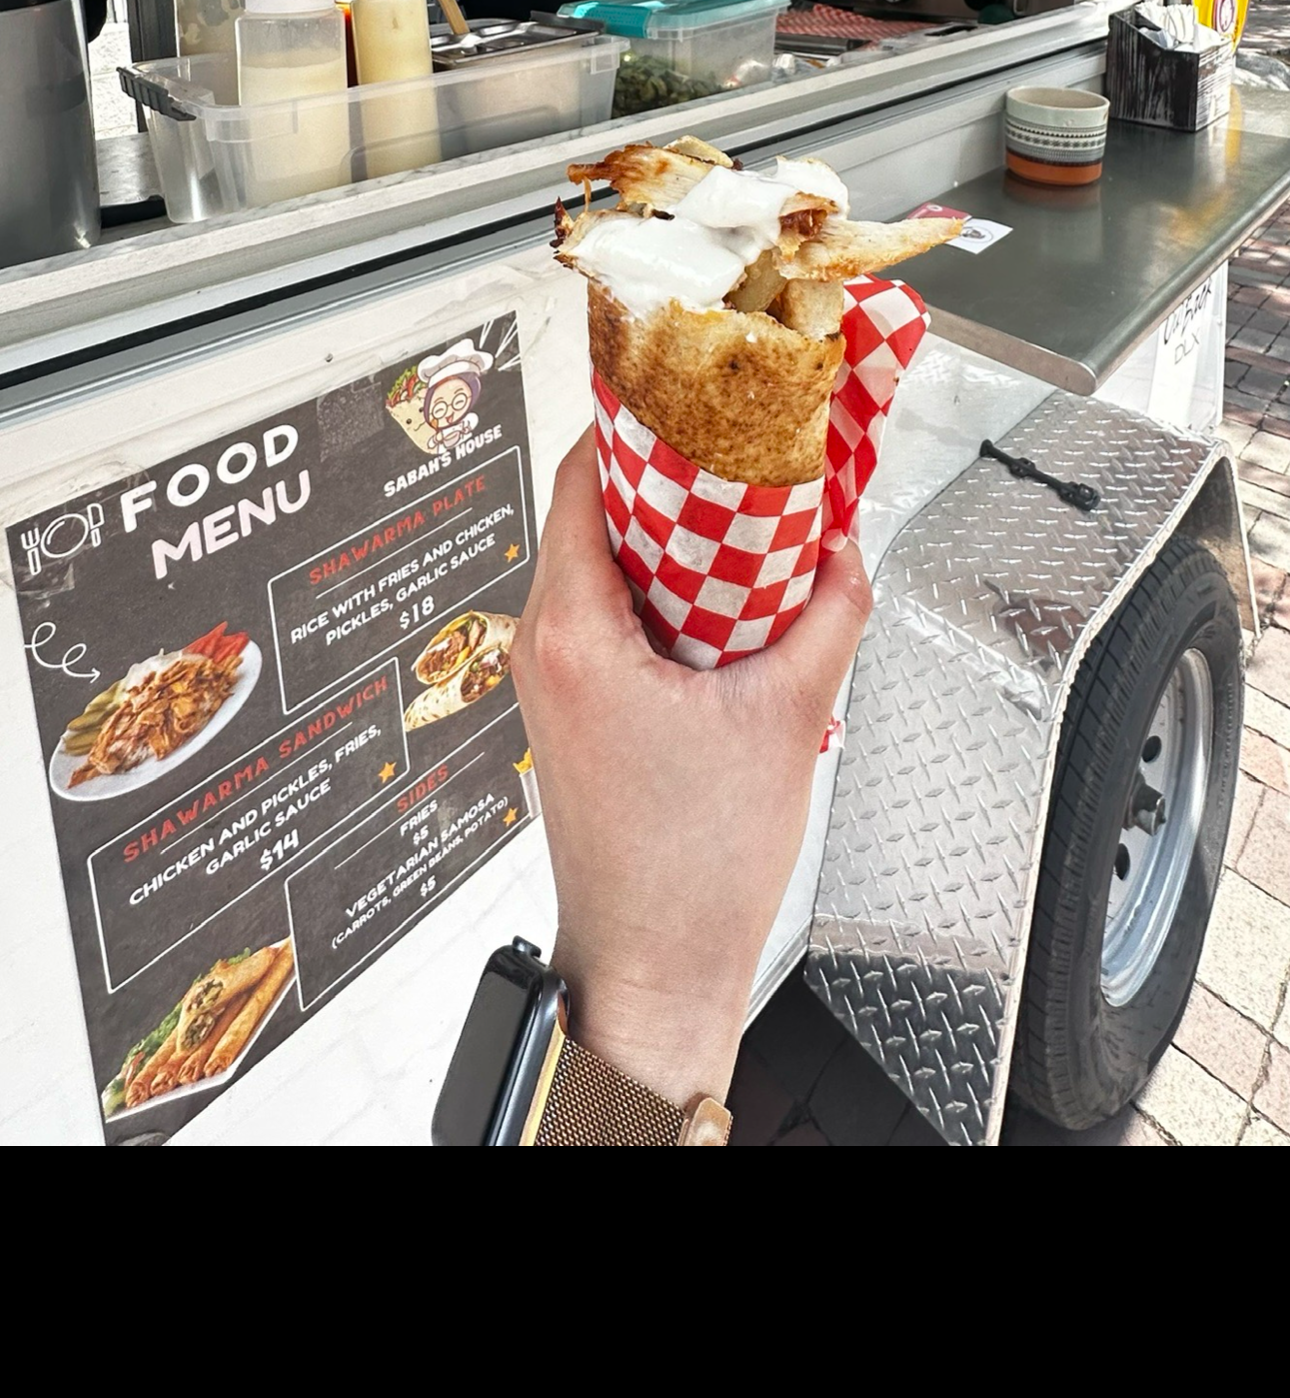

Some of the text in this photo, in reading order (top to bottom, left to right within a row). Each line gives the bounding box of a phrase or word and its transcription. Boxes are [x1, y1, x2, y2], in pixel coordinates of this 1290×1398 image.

[120, 424, 299, 533] FOOD
[383, 424, 502, 498] SABAH'S HOUSE
[151, 469, 311, 580] MENU
[290, 503, 515, 645] RICE WITH FRIES AND CHICKEN,
[309, 475, 486, 585] SHAWARMA PLATE
[325, 533, 496, 646] PICKLES, GARLIC SAUCE
[399, 595, 435, 630] $18
[123, 675, 389, 864] SHAWARMA SANDWICH
[129, 725, 382, 905] CHICKEN AND PICKLES, FRIES,
[397, 764, 449, 813] SIDES
[400, 799, 438, 836] FRIES
[205, 778, 331, 875] GARLIC SAUCE
[260, 829, 300, 870] $14
[332, 895, 392, 949] (CARROTS,
[392, 864, 427, 897] GREEN
[464, 796, 509, 837] POTATO)
[345, 793, 494, 918] VEGETARIAN SAMOSA
[413, 825, 429, 845] $5
[420, 875, 437, 897] $5
